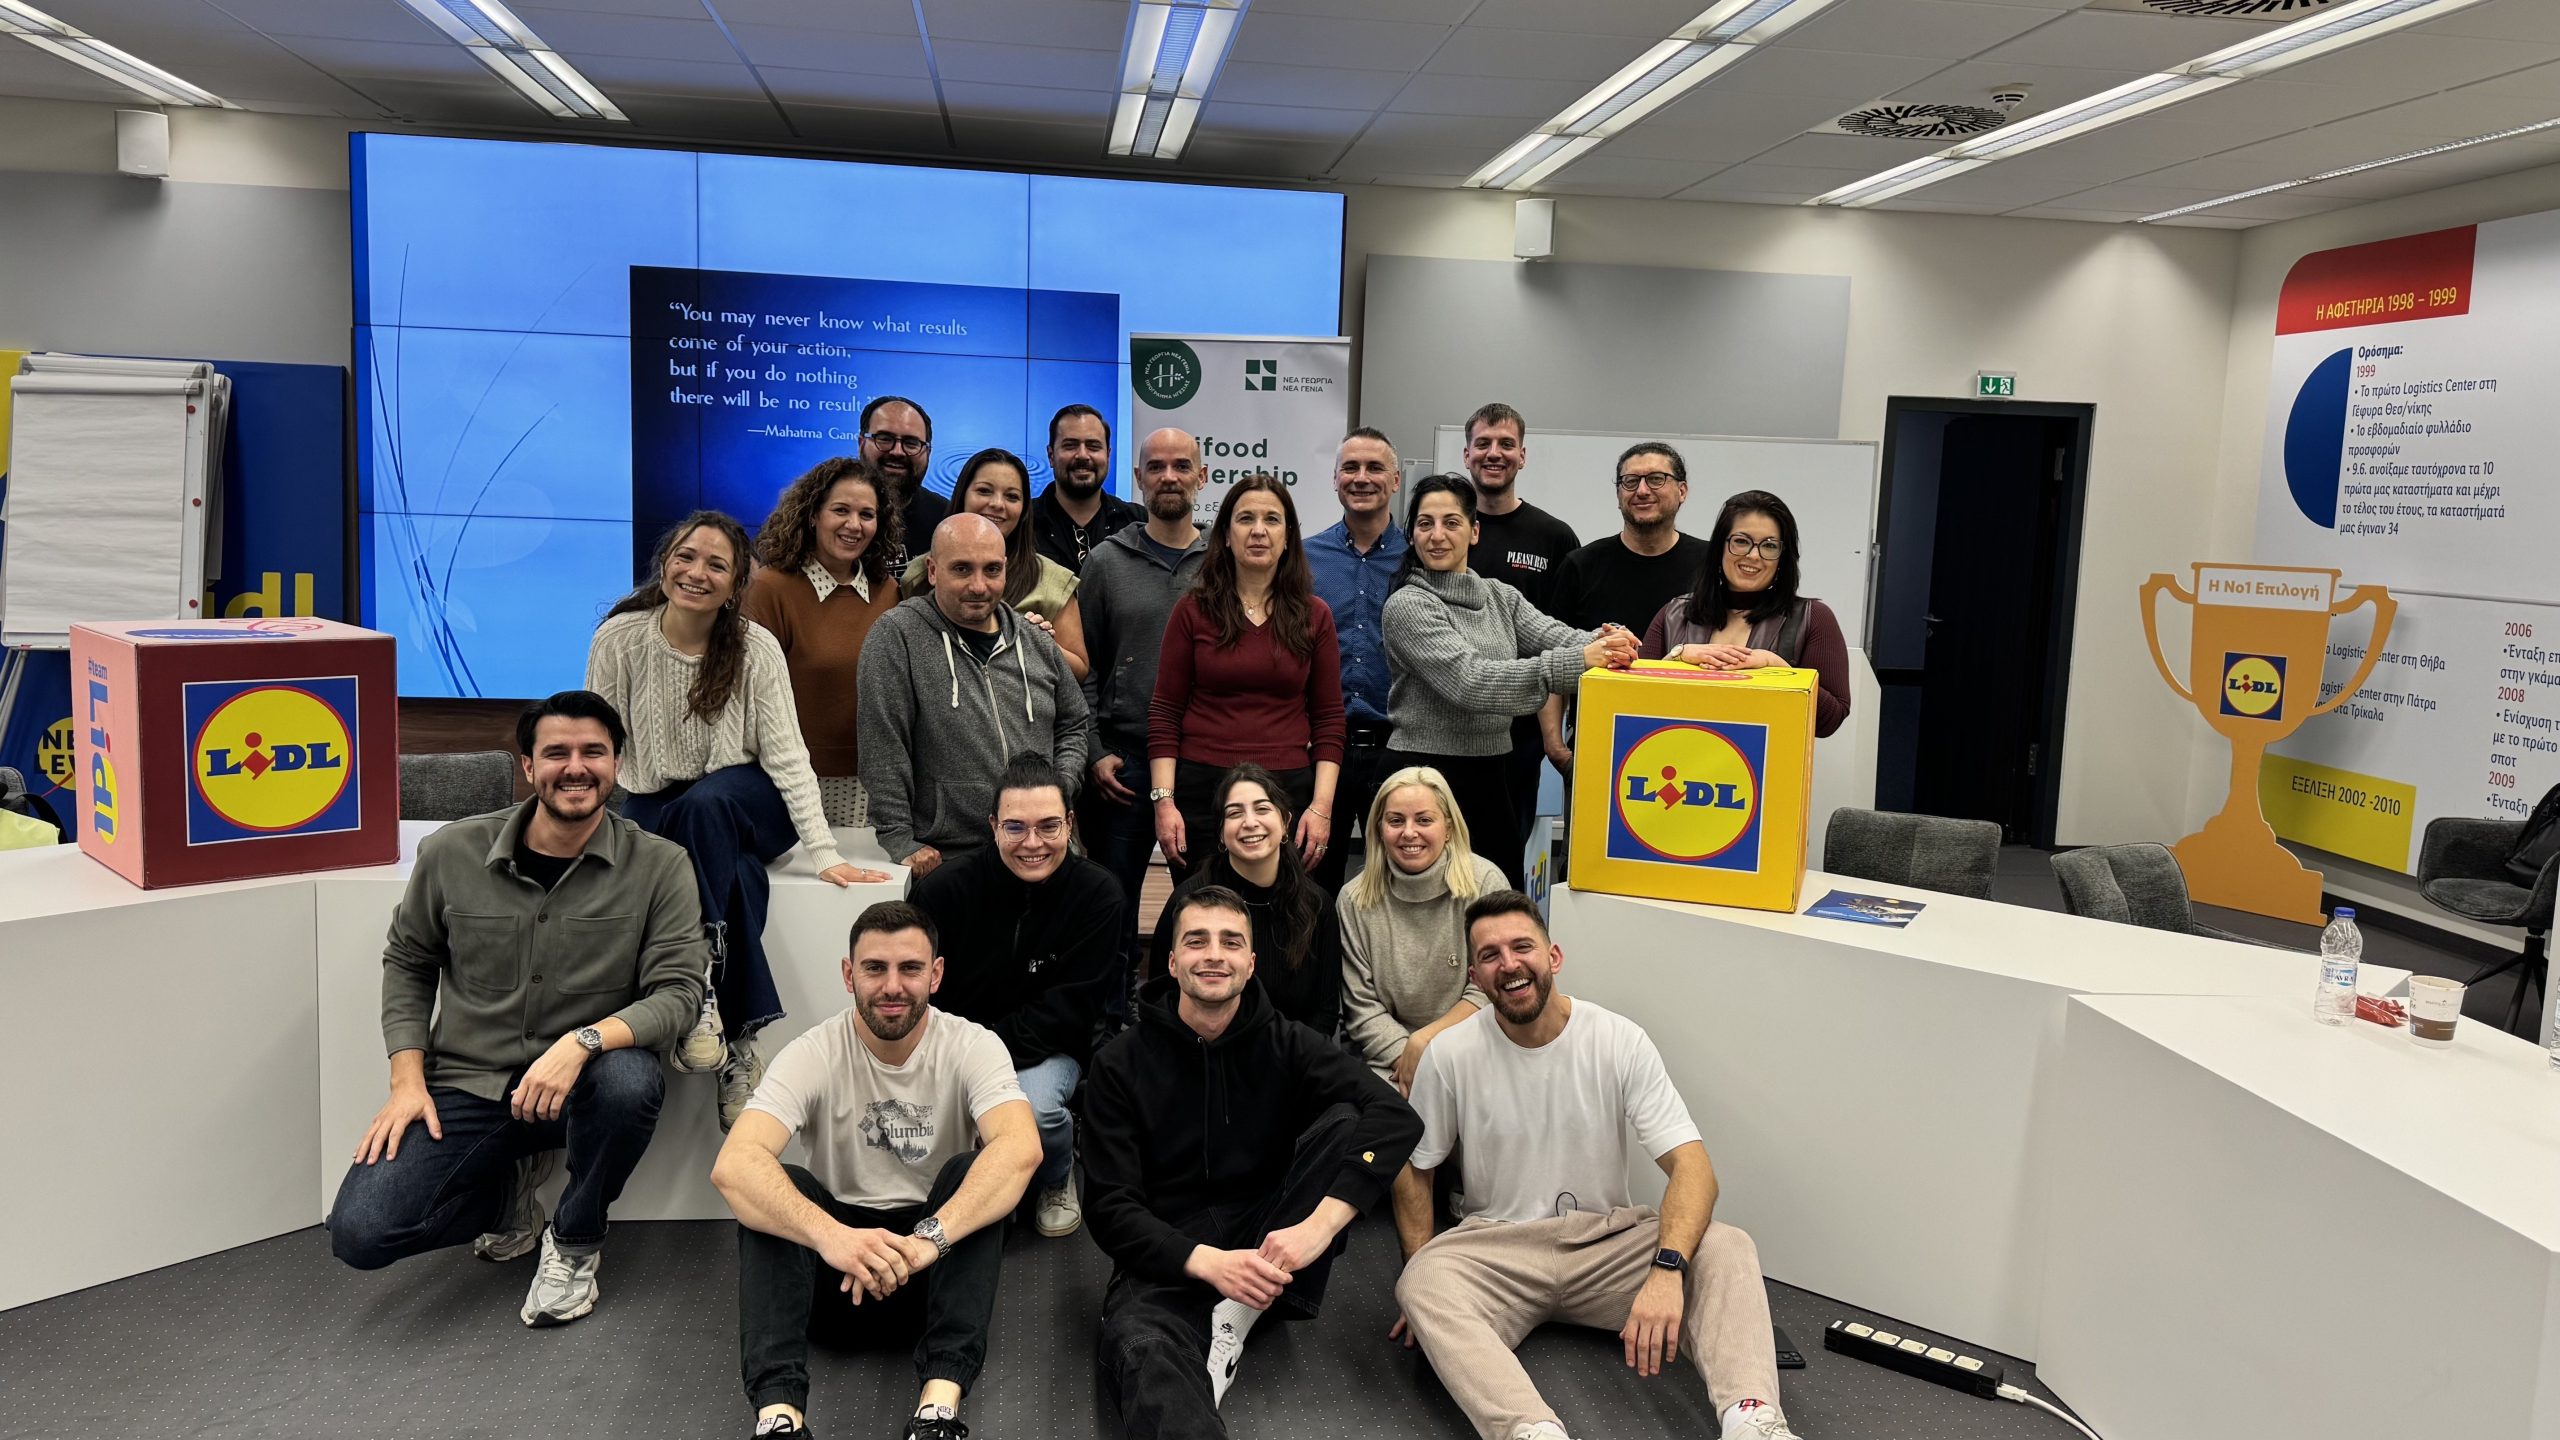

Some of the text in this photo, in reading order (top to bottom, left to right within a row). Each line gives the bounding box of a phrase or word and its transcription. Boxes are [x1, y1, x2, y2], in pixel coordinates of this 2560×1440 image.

[2316, 305, 2324, 320] Η
[2326, 297, 2384, 319] ΑΦΕΤΗΡΙΑ
[2388, 292, 2414, 312] 1998
[2428, 286, 2457, 307] 1999
[721, 310, 756, 328] may
[765, 314, 810, 327] never
[819, 311, 864, 330] know
[872, 315, 910, 333] what
[919, 319, 968, 336] results
[669, 334, 852, 358] come of your action,
[2358, 345, 2404, 360] Ορόσημα:
[670, 358, 858, 390] but if you do nothing
[2356, 364, 2376, 378] 1999
[1283, 376, 1333, 385] ΝΕΑ ΓΕΩΡΓΙΑ
[2360, 378, 2497, 400] Το πρώτο Logistics Center στη
[670, 386, 714, 405] there
[722, 390, 750, 406] will
[760, 389, 780, 408] be
[788, 396, 810, 410] no
[2352, 401, 2432, 418] Γέφυρα Θεσ/νίκης
[2367, 422, 2424, 438] εβδομαδιαίο
[2426, 420, 2472, 437] φυλλάδιο
[2348, 442, 2400, 458] προσφορών
[2352, 462, 2494, 478] 9.6. ανοίξαμε ταυτόχρονα τα 10
[2344, 482, 2500, 500] πρώτα μας καταστήματα και μέχρι
[2342, 504, 2351, 514] το
[2353, 502, 2376, 516] τέλος
[2379, 504, 2394, 514] του
[2396, 502, 2424, 518] έτους,
[2427, 506, 2438, 516] τα
[2340, 522, 2398, 536] μας έγιναν 34
[1507, 551, 1548, 570] PLEASURES
[2208, 580, 2220, 592] Η
[2256, 582, 2320, 600] Επιλογή
[2505, 622, 2532, 638] 2006
[2332, 644, 2366, 660] Logistic
[2401, 655, 2417, 670] στη
[2420, 654, 2445, 672] Θήβα
[2508, 644, 2546, 664] Ένταξη
[2500, 668, 2526, 684] στην
[2384, 690, 2404, 705] στην
[2407, 693, 2436, 712] Πάτρα
[2498, 686, 2525, 702] 2008
[2350, 706, 2384, 722] Τρίκαλα
[2504, 708, 2552, 733] Ενίσχυση
[88, 656, 114, 836] #team Lidl
[2492, 732, 2558, 752] με το πρώτο
[2490, 753, 2517, 768] σποτ
[2488, 770, 2515, 788] 2009
[2292, 775, 2400, 816] ΕΞΕΛΙΞΗ 2002 -2010
[2492, 793, 2528, 817] Ένταξη
